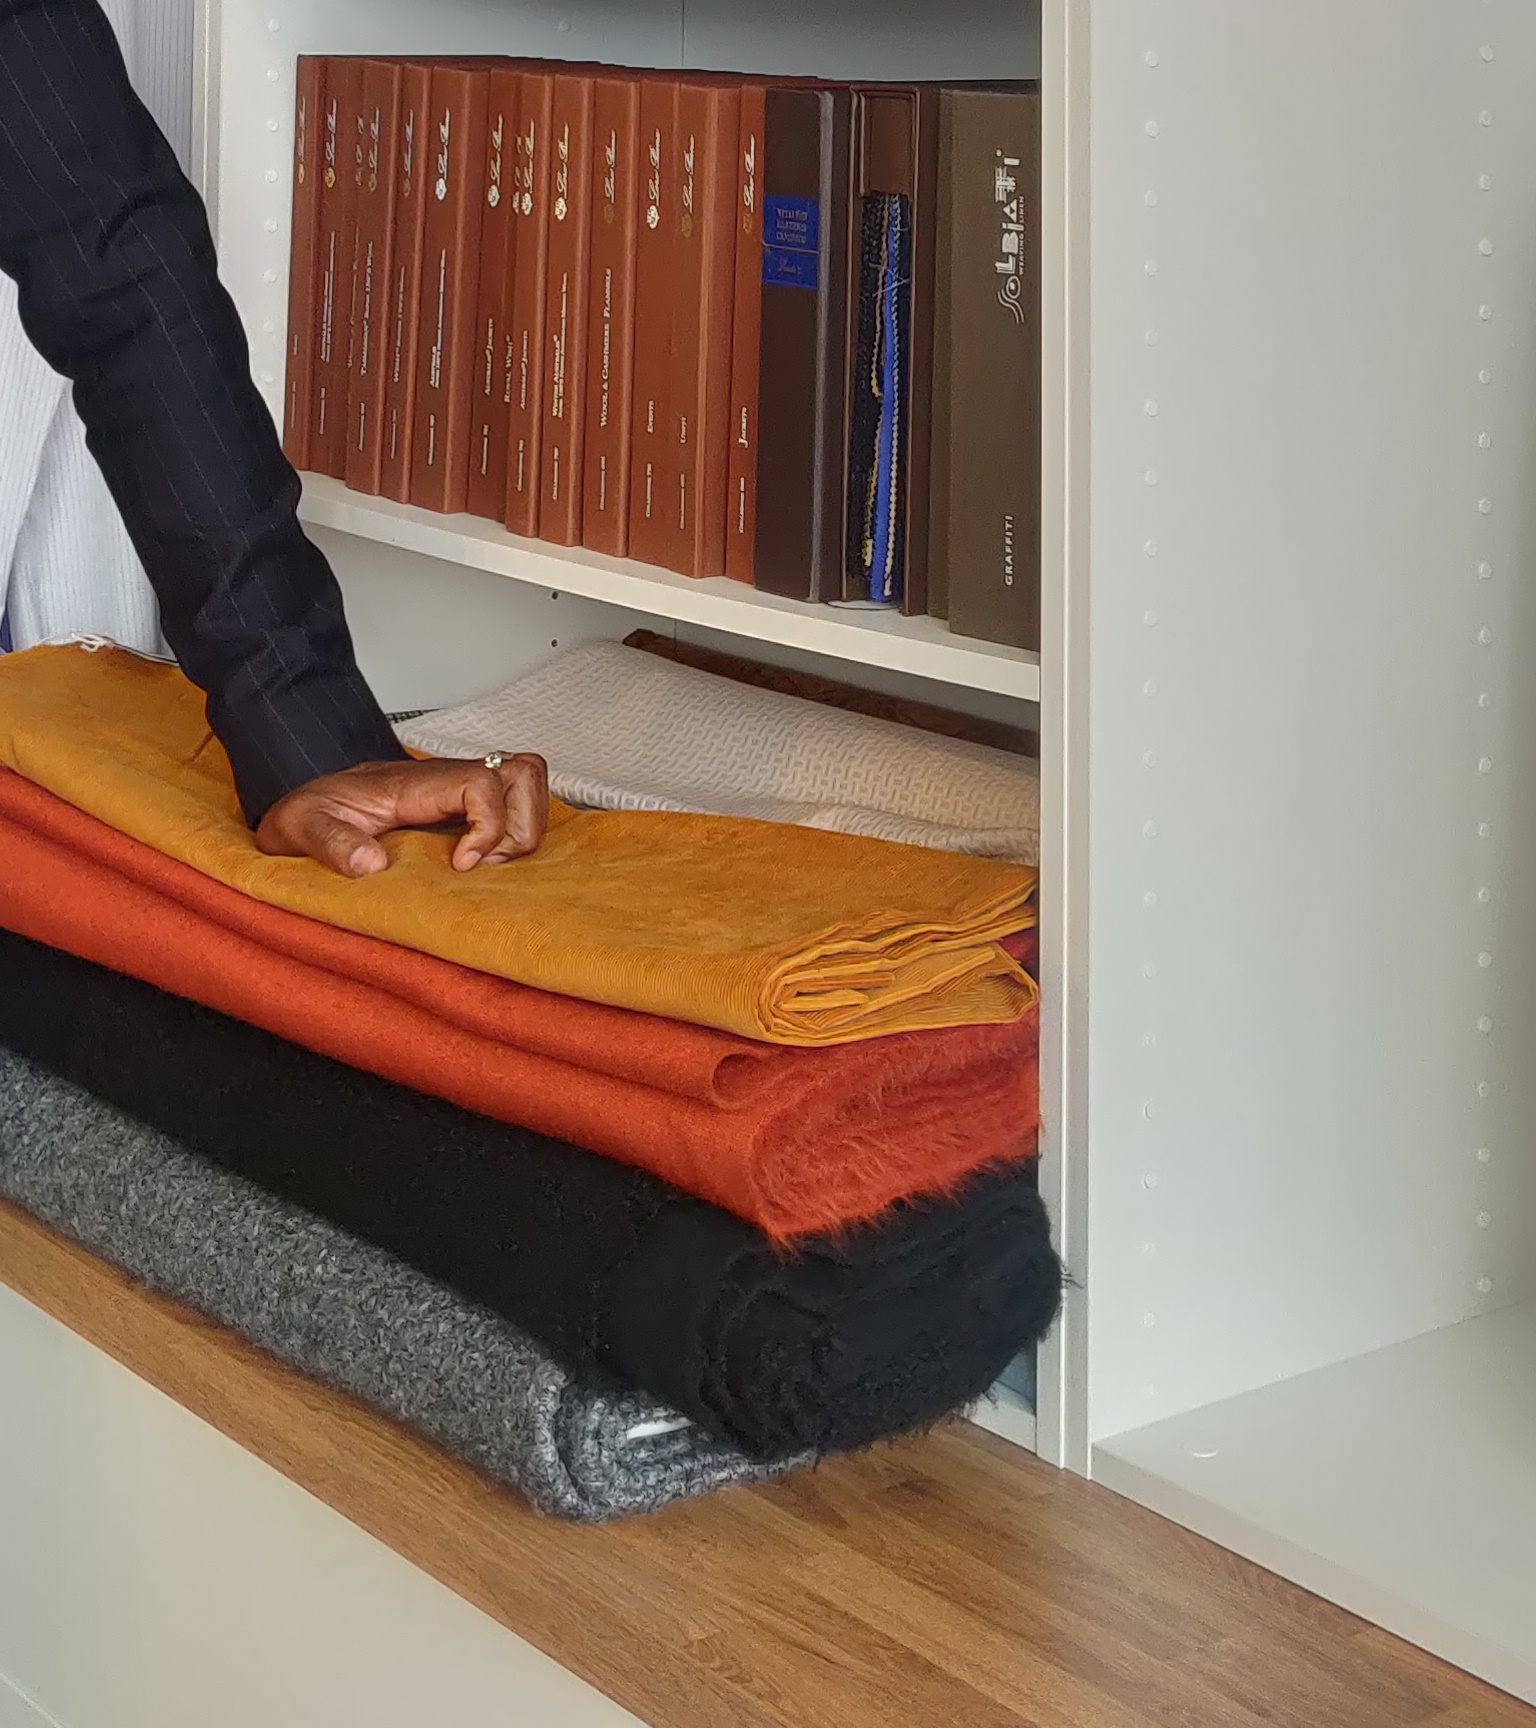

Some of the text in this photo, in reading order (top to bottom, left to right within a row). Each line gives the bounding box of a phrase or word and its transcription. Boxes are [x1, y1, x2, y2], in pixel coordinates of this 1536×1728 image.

[600, 392, 608, 427] WOOL
[738, 407, 748, 448] JACKETS
[1005, 515, 1014, 586] GRAFFITI
